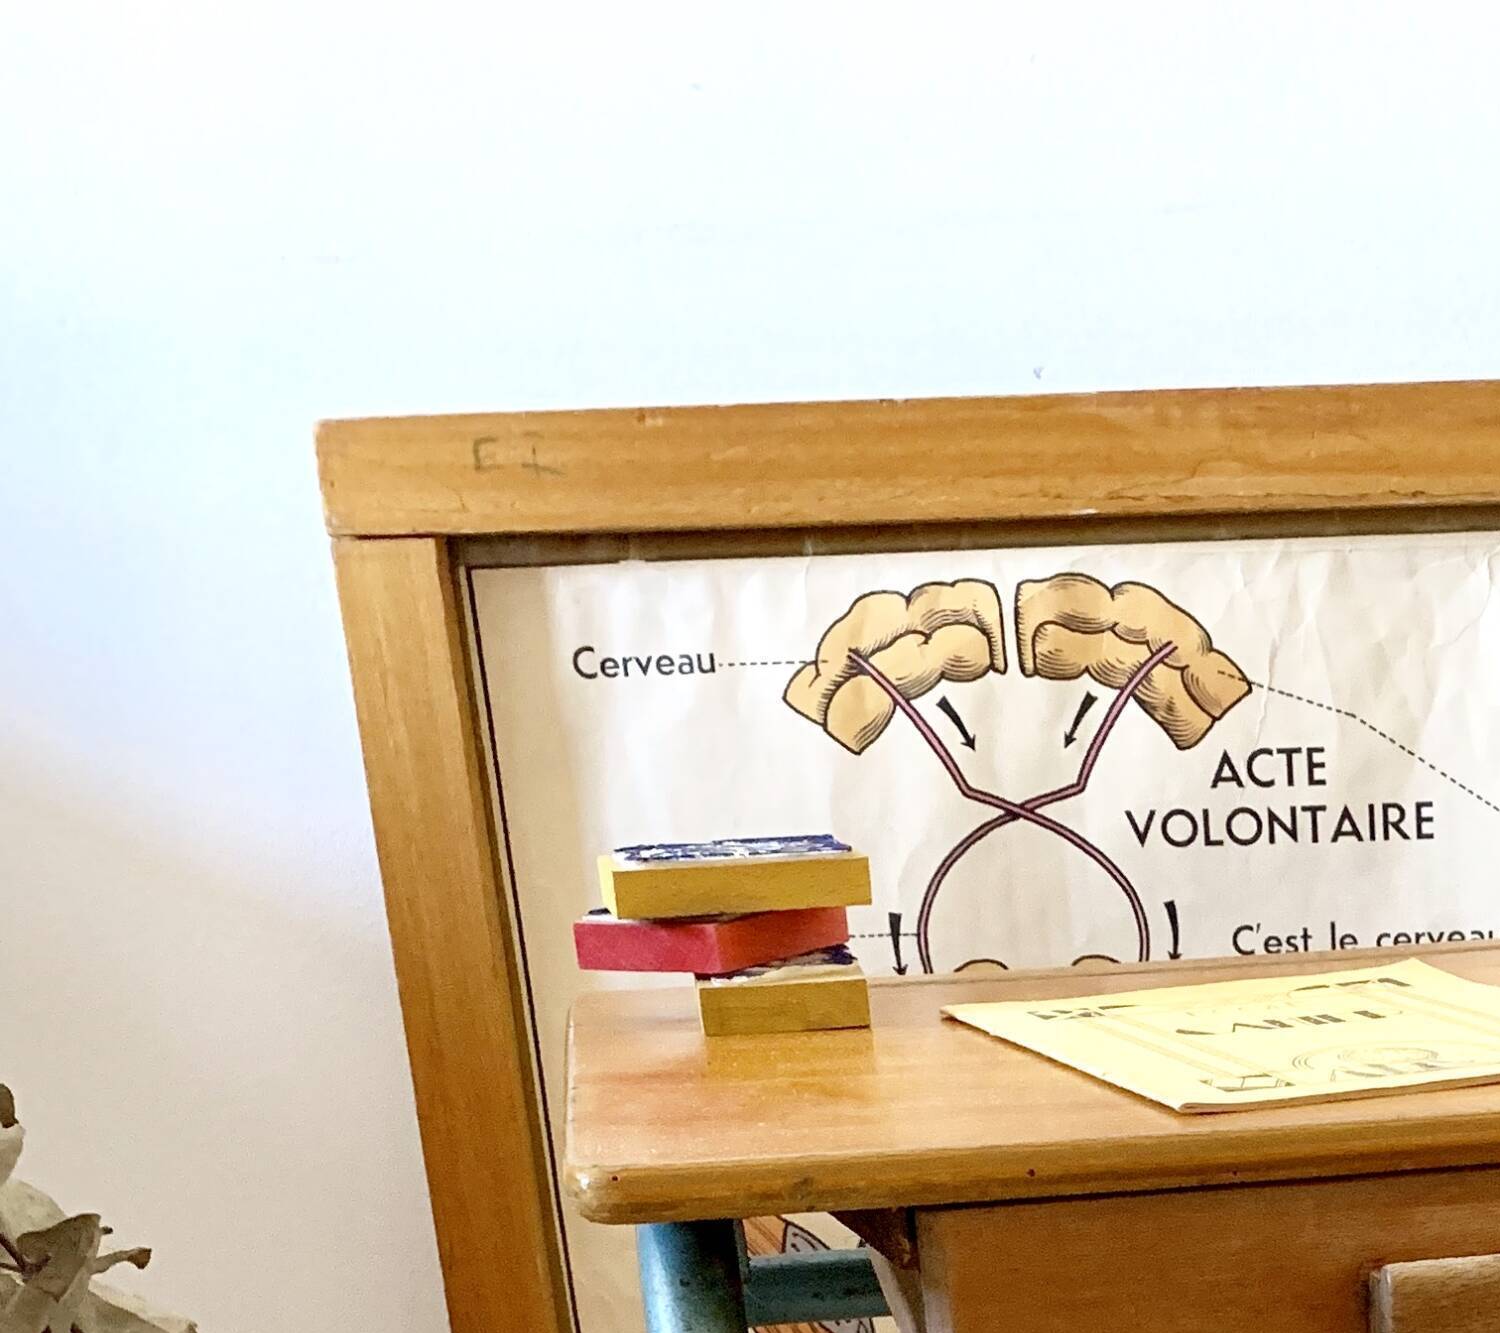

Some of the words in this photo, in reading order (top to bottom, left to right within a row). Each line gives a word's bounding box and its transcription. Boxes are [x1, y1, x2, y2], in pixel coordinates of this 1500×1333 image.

[572, 645, 717, 681] Cerveau
[1210, 745, 1328, 789] ACTE
[1125, 800, 1436, 848] VOLONTAIRE
[1231, 922, 1314, 956] C'est
[1329, 920, 1358, 951] le
